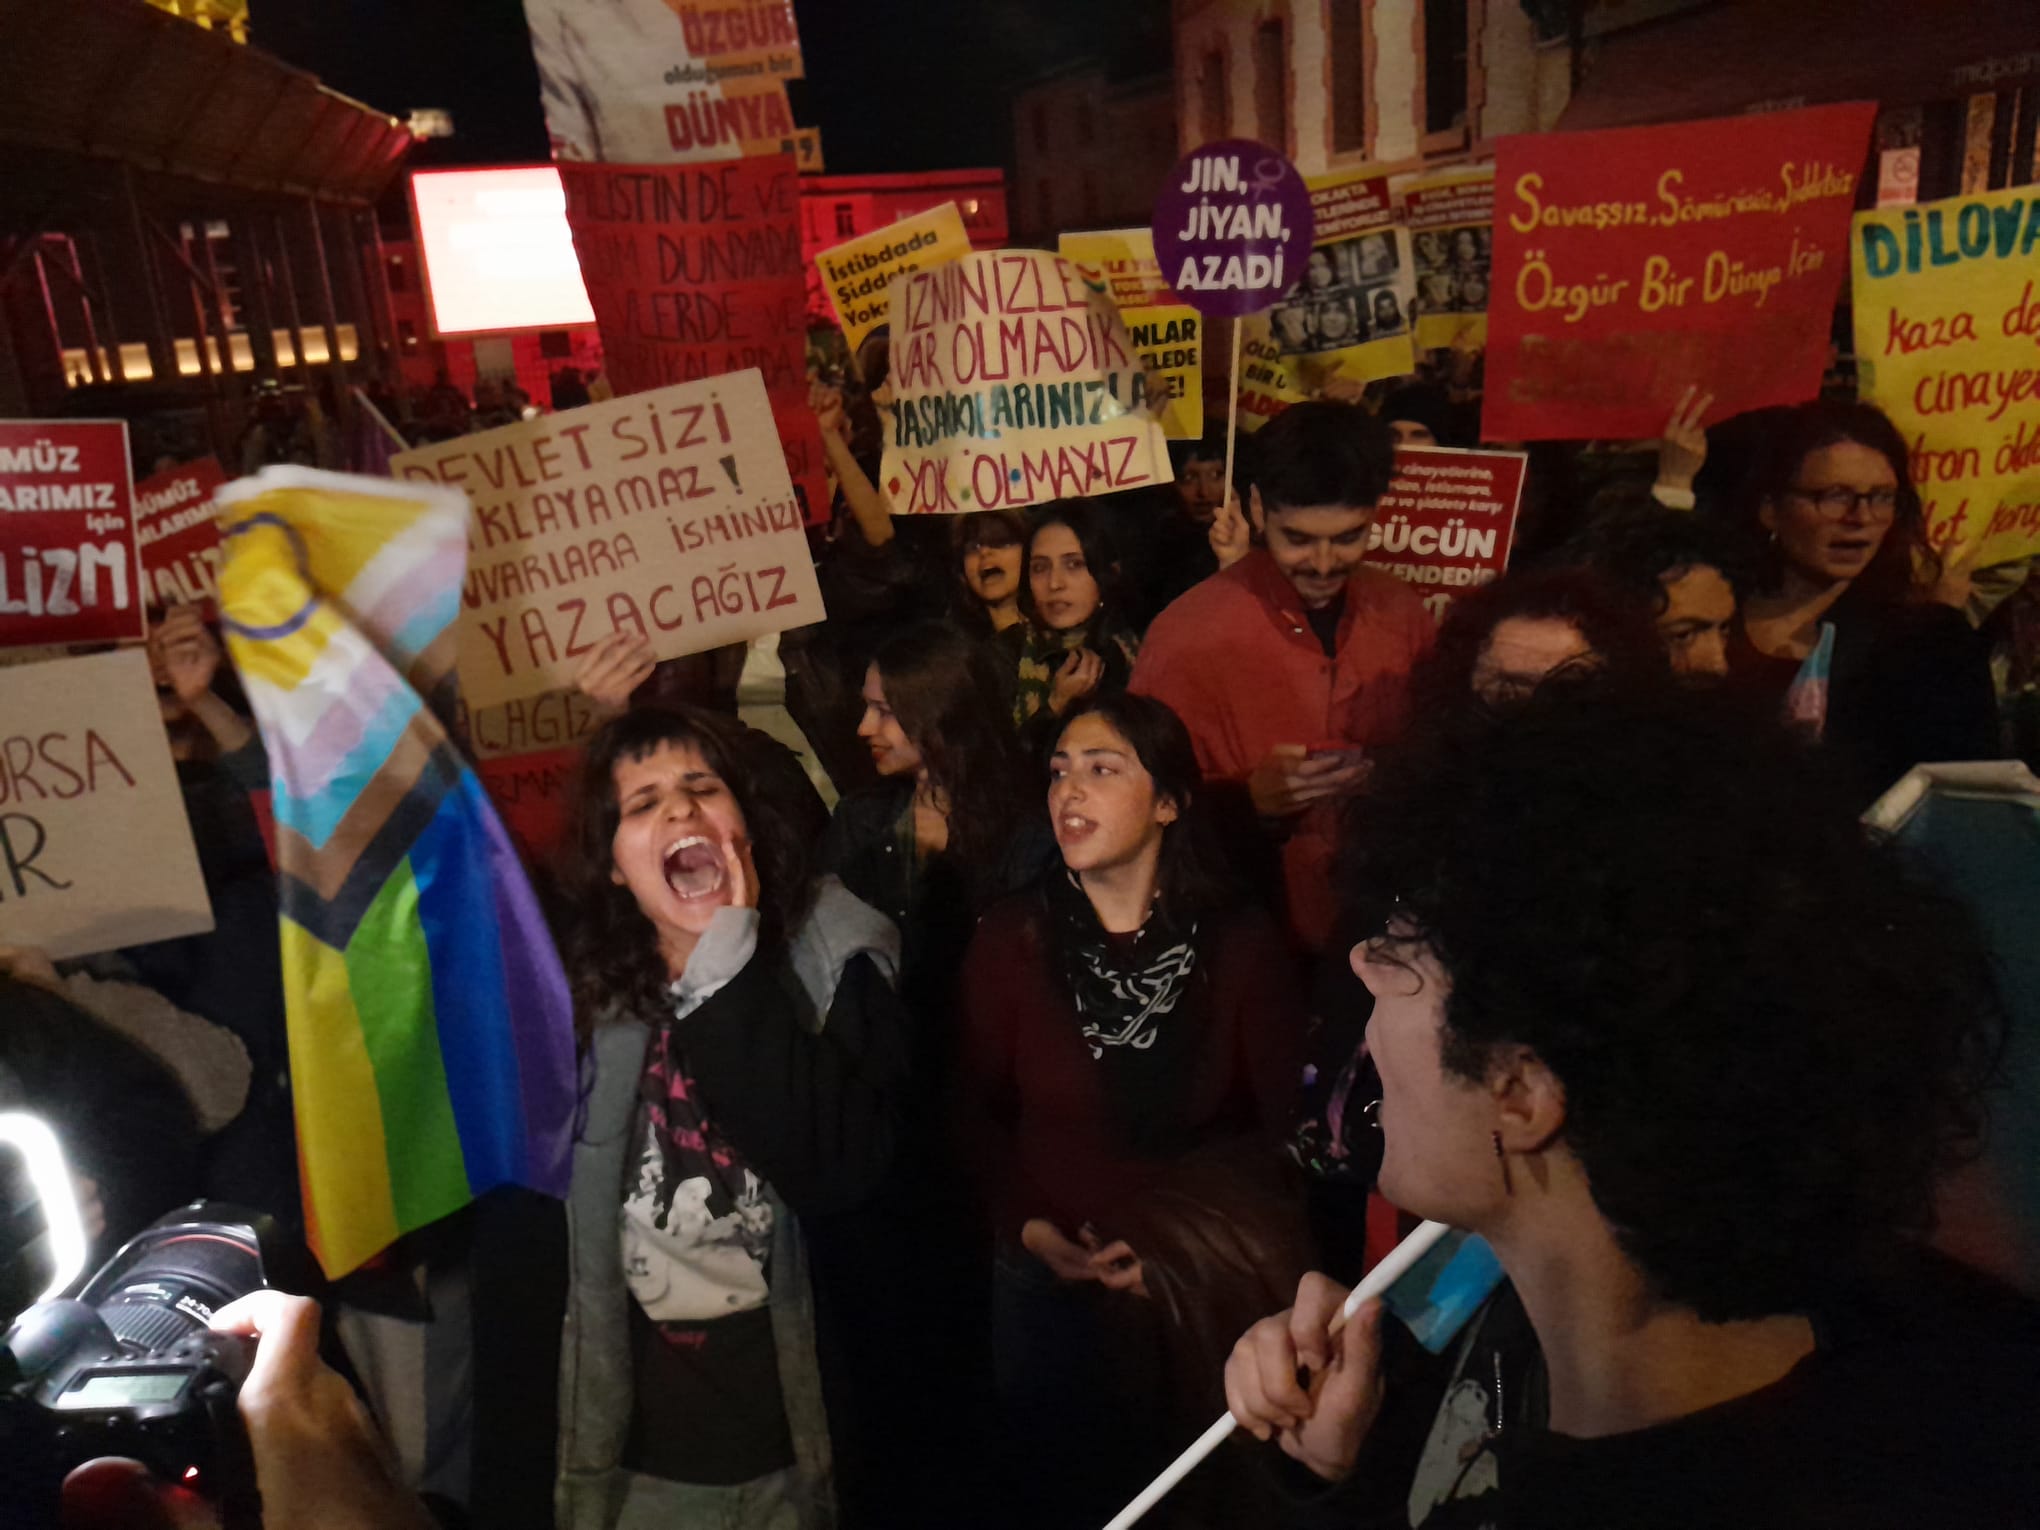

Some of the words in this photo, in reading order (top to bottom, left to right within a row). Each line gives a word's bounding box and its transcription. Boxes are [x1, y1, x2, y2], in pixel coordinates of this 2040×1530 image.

[768, 55, 793, 73] bir
[664, 90, 791, 152] DÜNYA
[1181, 156, 1248, 194] JIN,
[1178, 197, 1291, 242] JİYAN,
[824, 230, 938, 283] İstibdada
[1176, 245, 1284, 290] AZADİ
[1515, 249, 1629, 323] Özgür
[1638, 255, 1693, 312] Bir
[1703, 250, 1781, 308] Dünya
[952, 316, 1129, 385] OLMADIK
[1126, 318, 1196, 348] NLAR
[1884, 307, 1977, 355] kaza
[1913, 368, 2040, 422] cinaye
[611, 392, 733, 461] SİZİ
[903, 456, 957, 512] YOK
[1910, 433, 1979, 484] tron
[86, 514, 125, 534] için
[468, 455, 744, 552] KLAYAMAZ!
[1924, 498, 1970, 548] let
[480, 562, 797, 676] YAZACAĞIZ
